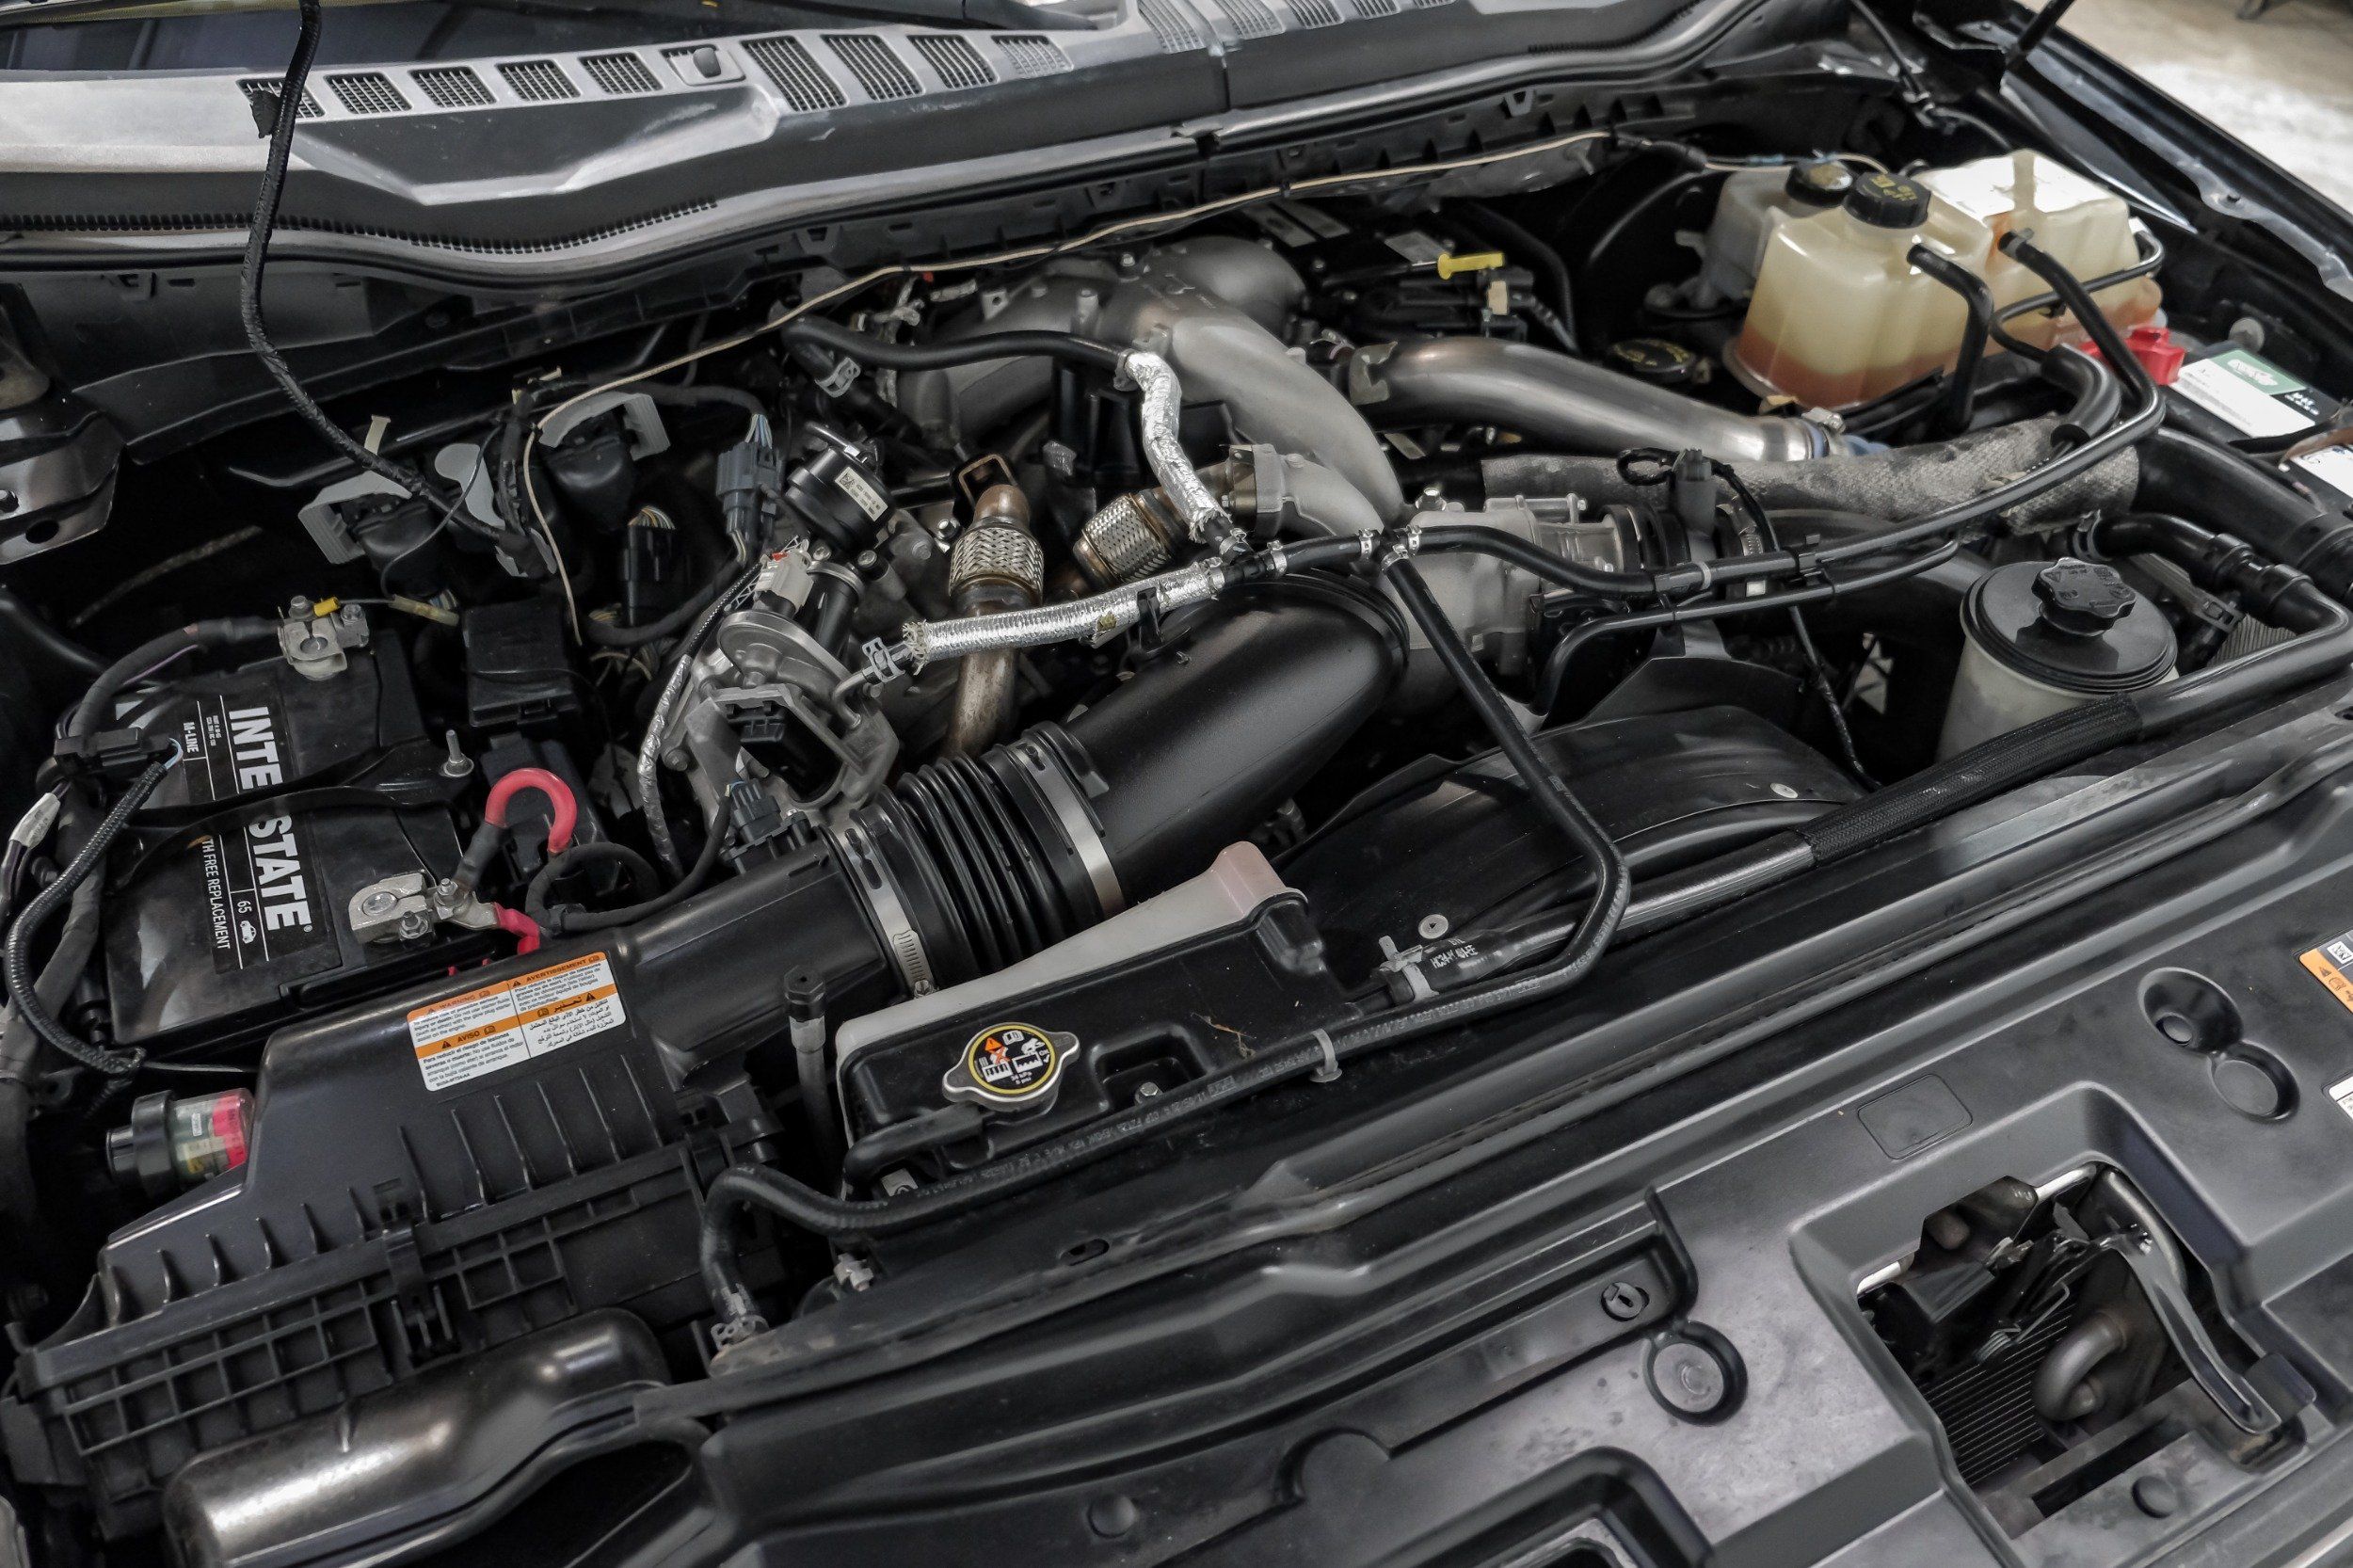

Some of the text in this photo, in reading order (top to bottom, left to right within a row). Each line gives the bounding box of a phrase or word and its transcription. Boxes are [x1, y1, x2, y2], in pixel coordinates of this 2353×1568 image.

[183, 721, 200, 753] M-LINE
[203, 856, 217, 878] FREE
[207, 879, 231, 950] REPLACEMENT
[237, 900, 252, 914] 65
[526, 959, 585, 981] AVERTISSEMENT
[440, 995, 474, 1009] WARNING
[456, 1030, 480, 1042] AVISO
